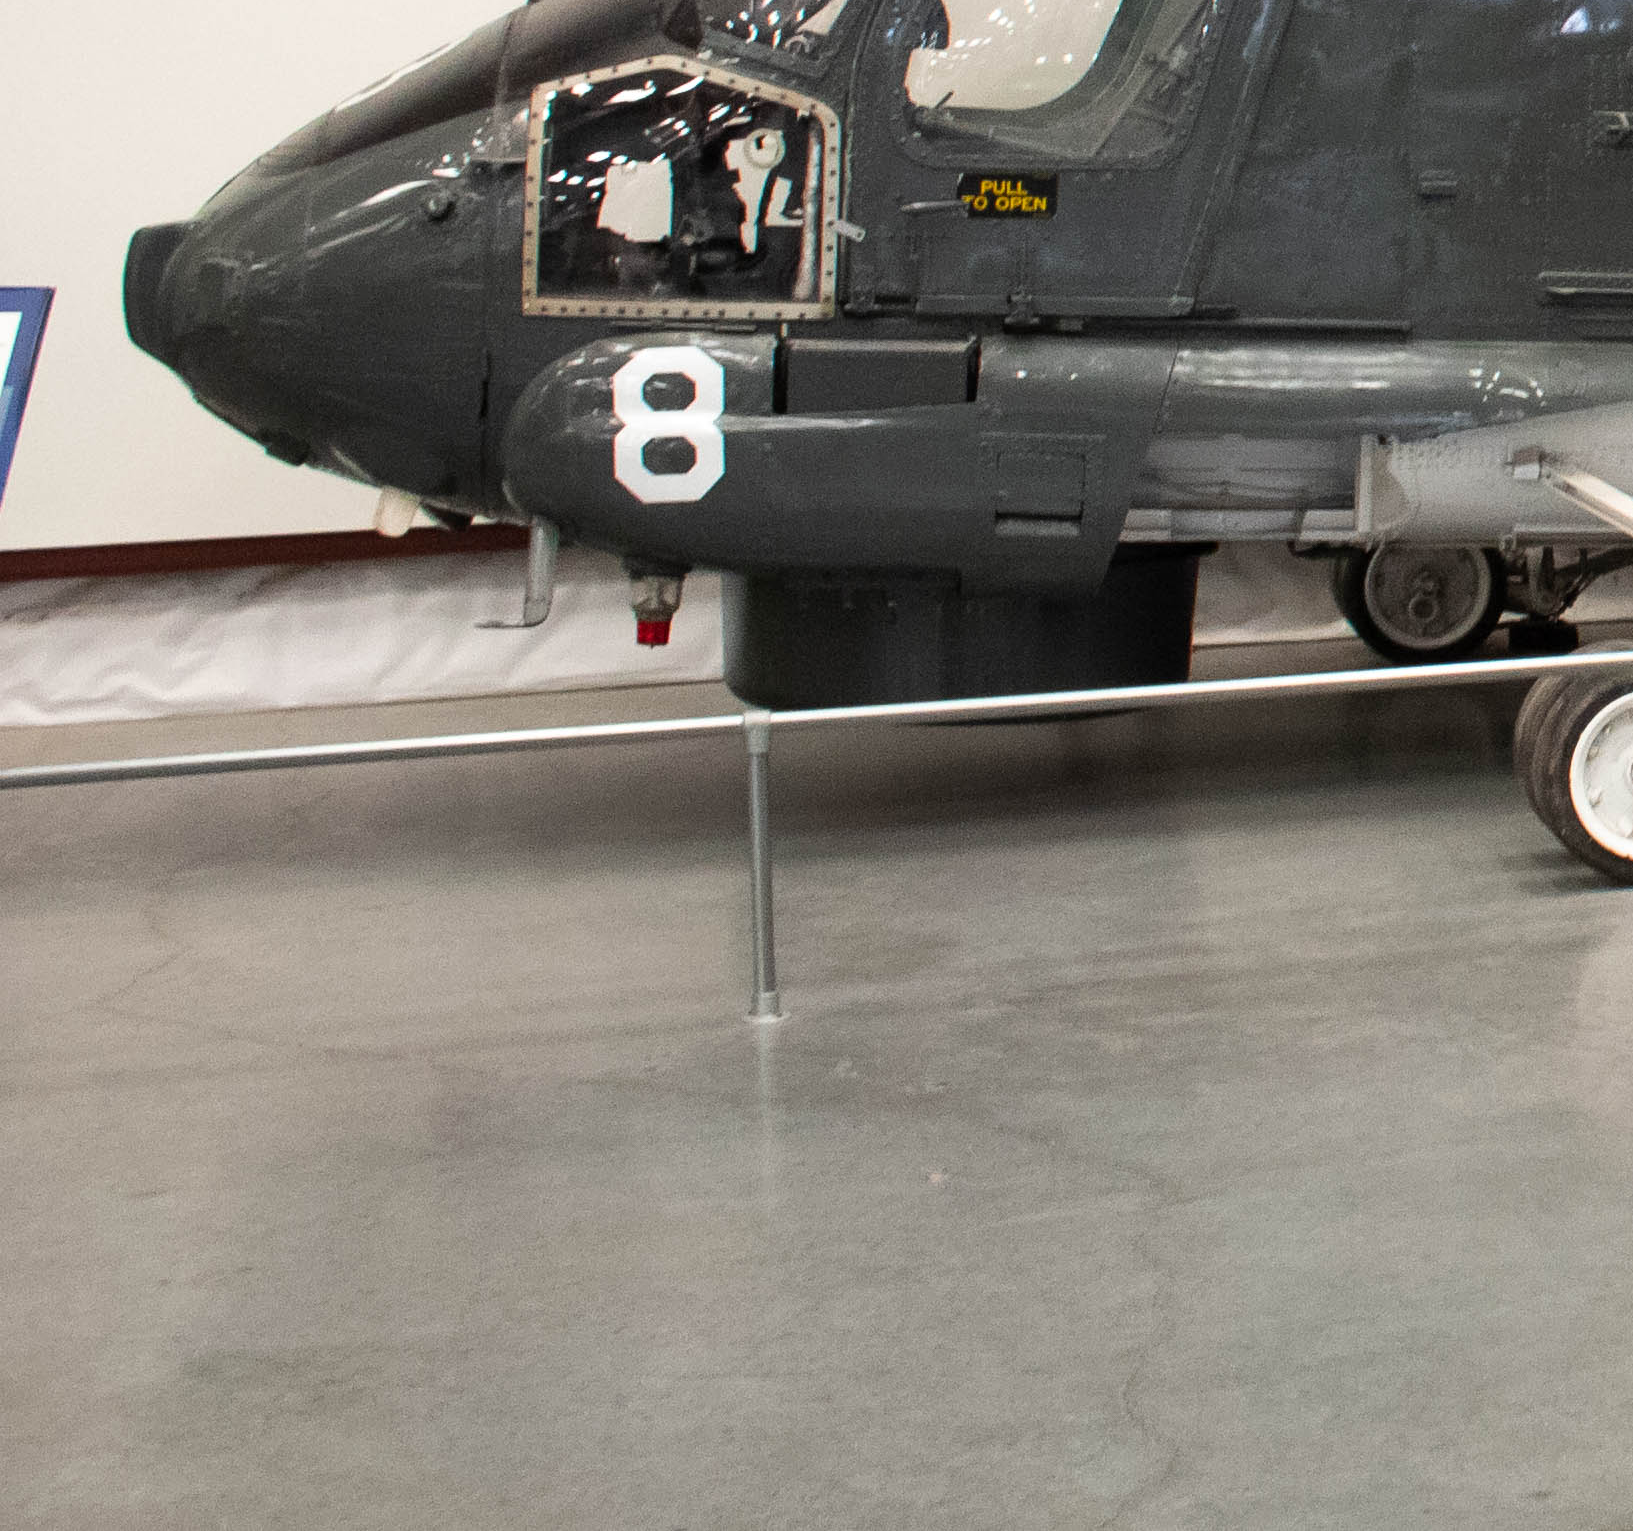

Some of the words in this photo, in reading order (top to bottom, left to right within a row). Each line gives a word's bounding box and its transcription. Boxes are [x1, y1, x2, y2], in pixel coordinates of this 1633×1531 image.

[980, 179, 1028, 196] PULL
[961, 195, 988, 211] TO
[995, 196, 1048, 212] OPEN
[613, 345, 726, 504] 8
